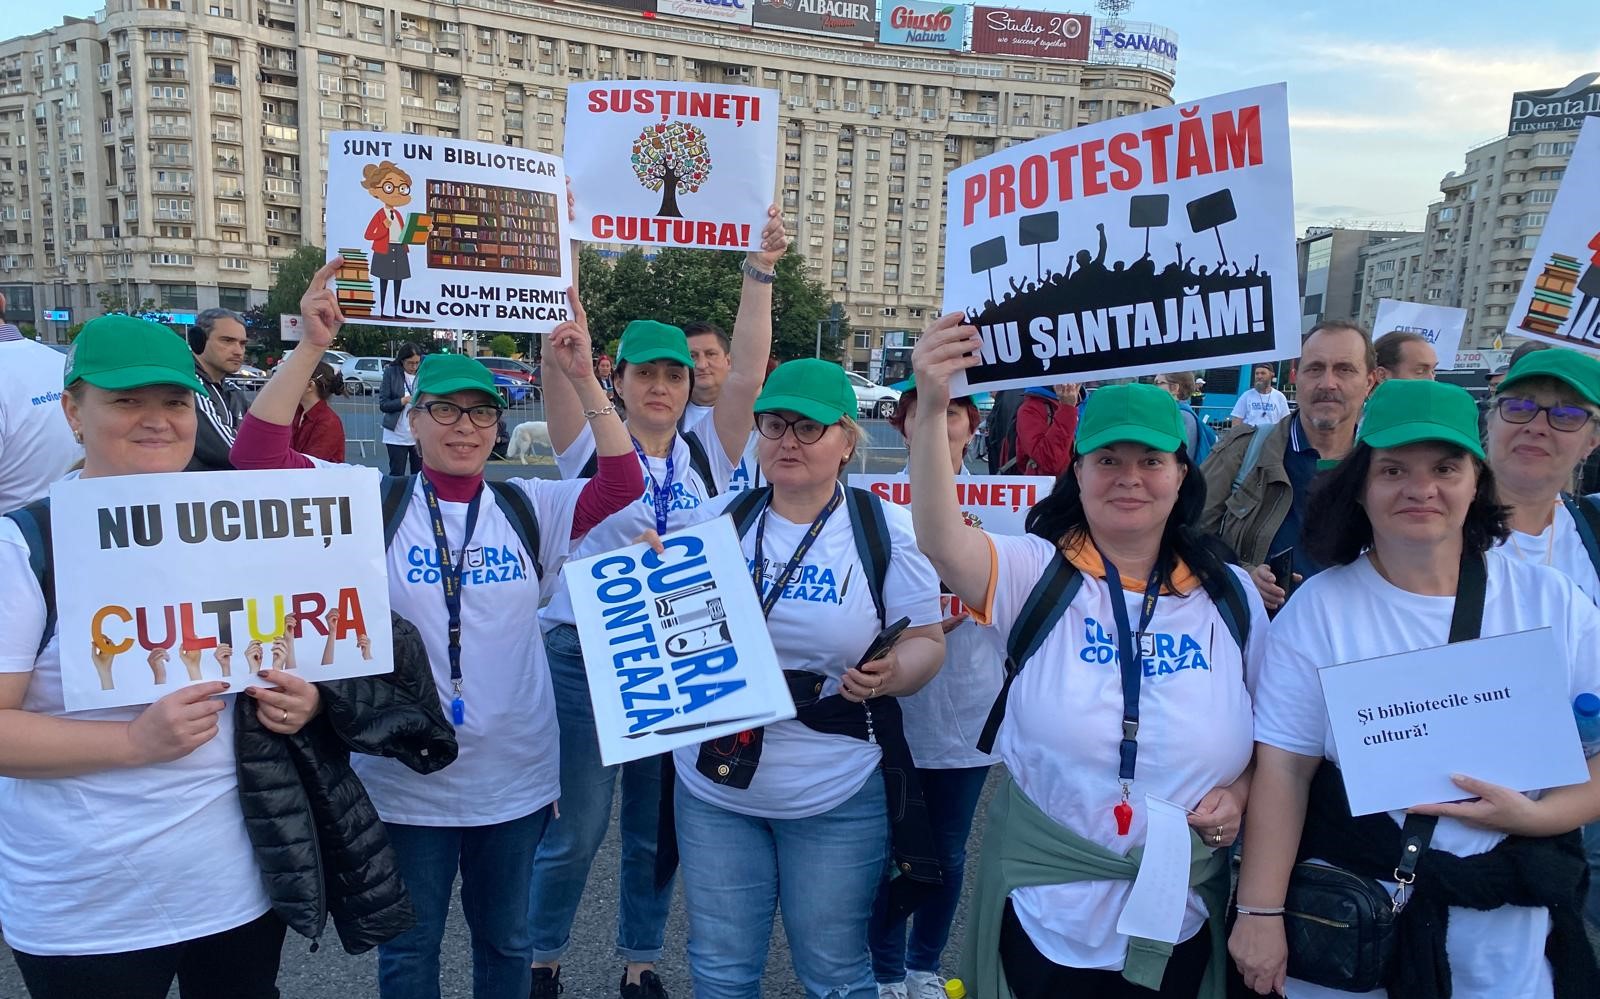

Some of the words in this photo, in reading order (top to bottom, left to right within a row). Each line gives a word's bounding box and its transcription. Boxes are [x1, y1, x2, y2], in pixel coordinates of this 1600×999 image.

[798, 0, 871, 22] ALBACHER
[890, 6, 952, 31] Giusto
[987, 11, 1045, 34] Studio
[906, 30, 947, 43] Natura
[1040, 39, 1067, 50] together
[1114, 32, 1178, 60] SANADOR
[588, 89, 760, 128] SUSȚINEȚI
[344, 139, 392, 157] SUNT
[403, 143, 432, 161] UN
[444, 148, 556, 178] BIBLIOTECAR
[963, 105, 1263, 227] PROTESTĂM
[591, 215, 750, 247] CULTURA!
[441, 284, 500, 300] NU-MI
[506, 287, 566, 304] PERMIT
[401, 299, 432, 315] UN
[436, 301, 491, 318] CONT
[496, 304, 568, 321] BANCAR
[976, 321, 1022, 366] NU
[1029, 285, 1265, 371] ȘANTAJĂM!
[870, 482, 1036, 512] SUINEȚI
[97, 504, 163, 550] NU
[176, 496, 353, 549] UCIDEȚI
[91, 587, 367, 655] CULTURA
[641, 536, 747, 714] CULTURA
[1357, 708, 1374, 725] Și
[1378, 693, 1469, 719] bibliotecile
[1474, 686, 1511, 704] sunt
[1363, 723, 1430, 747] cultură!
